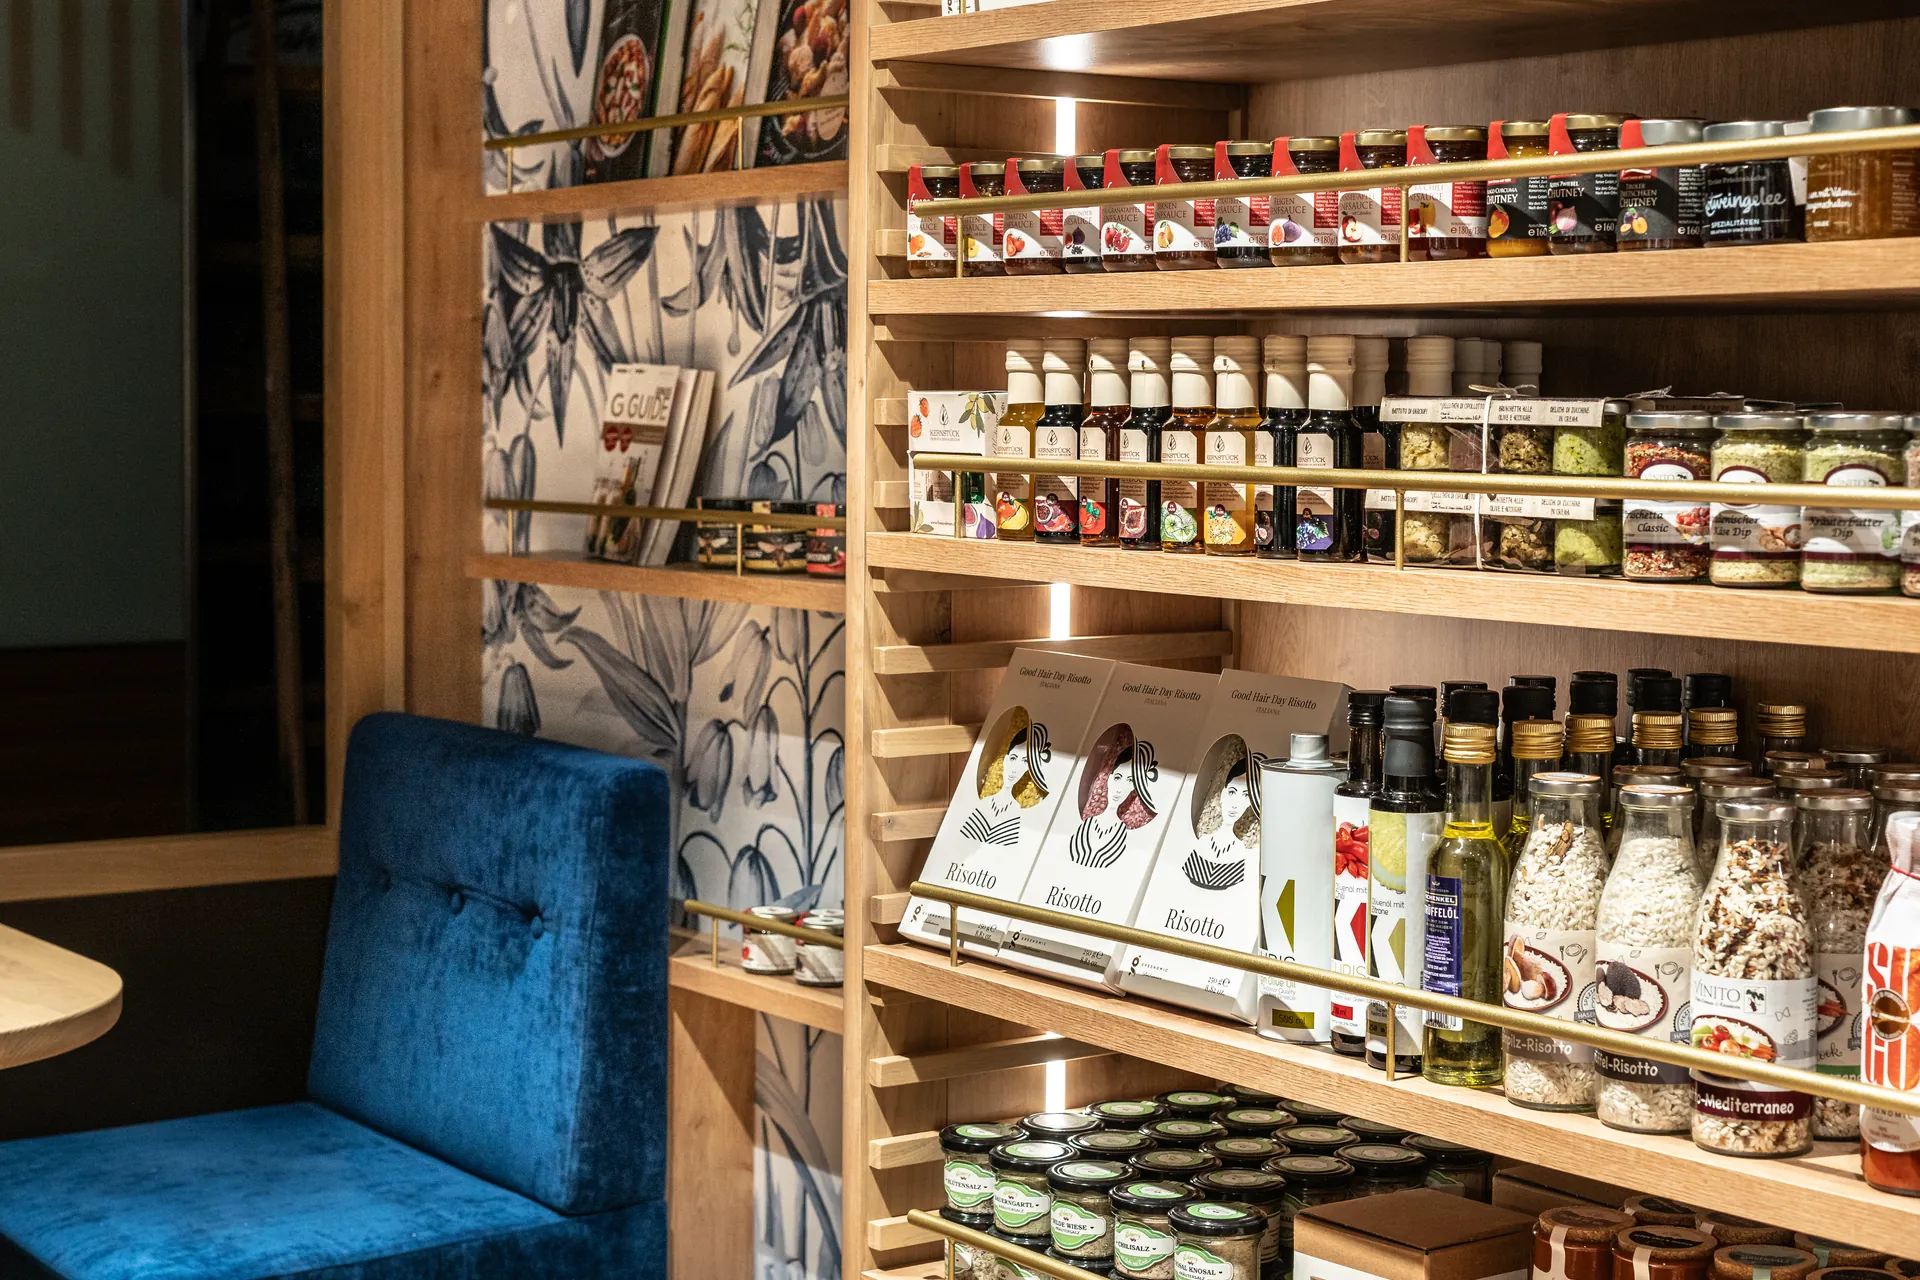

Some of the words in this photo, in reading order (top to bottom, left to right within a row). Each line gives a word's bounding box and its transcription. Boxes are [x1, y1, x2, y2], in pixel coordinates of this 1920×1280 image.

[1711, 218, 1760, 229] SPEZIALITÄTEN
[1809, 515, 1885, 527] Kräuterbutter
[1637, 523, 1669, 533] Classic
[1733, 527, 1752, 539] Dip
[1832, 528, 1854, 540] Dip
[1019, 666, 1037, 677] Good
[1037, 668, 1053, 680] Hair
[1053, 670, 1067, 682] Day
[1067, 672, 1092, 685] Risotto
[1122, 682, 1142, 693] Good
[1142, 684, 1159, 696] Hair
[1159, 686, 1174, 698] Day
[1174, 688, 1201, 702] Risotto
[1231, 689, 1252, 701] Good
[1252, 691, 1271, 704] Hair
[1271, 694, 1287, 707] Day
[1287, 696, 1317, 710] Risotto
[945, 862, 997, 889] Risotto
[1356, 886, 1368, 894] mit
[1045, 885, 1102, 915] Risotto
[1393, 901, 1405, 909] mit
[1164, 907, 1225, 939] Risotto
[1695, 979, 1741, 1003] VINITO
[1066, 1221, 1087, 1231] WIESE
[1117, 1241, 1150, 1252] CHILISALZ
[1188, 1266, 1216, 1276] KNOSAL
